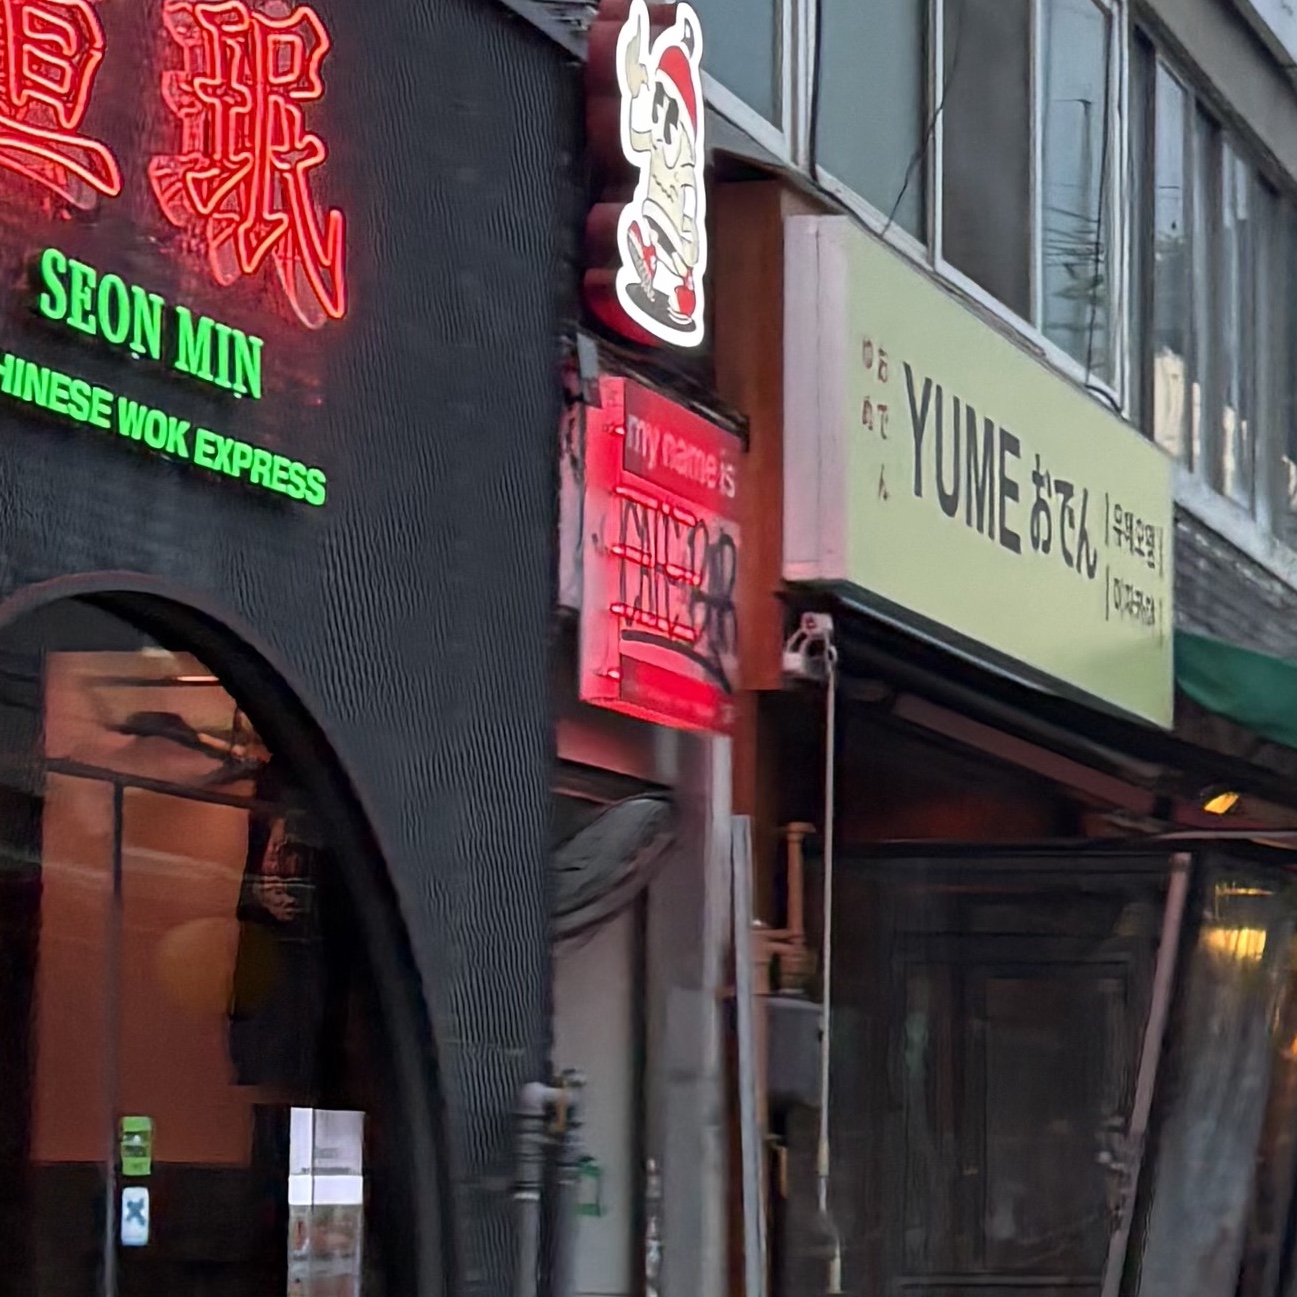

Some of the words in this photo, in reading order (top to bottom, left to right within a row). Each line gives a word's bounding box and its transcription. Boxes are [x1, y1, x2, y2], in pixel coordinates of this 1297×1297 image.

[40, 248, 165, 361] SEON
[174, 305, 265, 400] MIN
[117, 395, 191, 459] WOK
[193, 427, 327, 506] EXPRESS
[626, 414, 661, 470] my
[661, 431, 717, 489] name
[718, 449, 736, 498] is
[903, 360, 1022, 555] YUME
[1030, 453, 1098, 579] おでん
